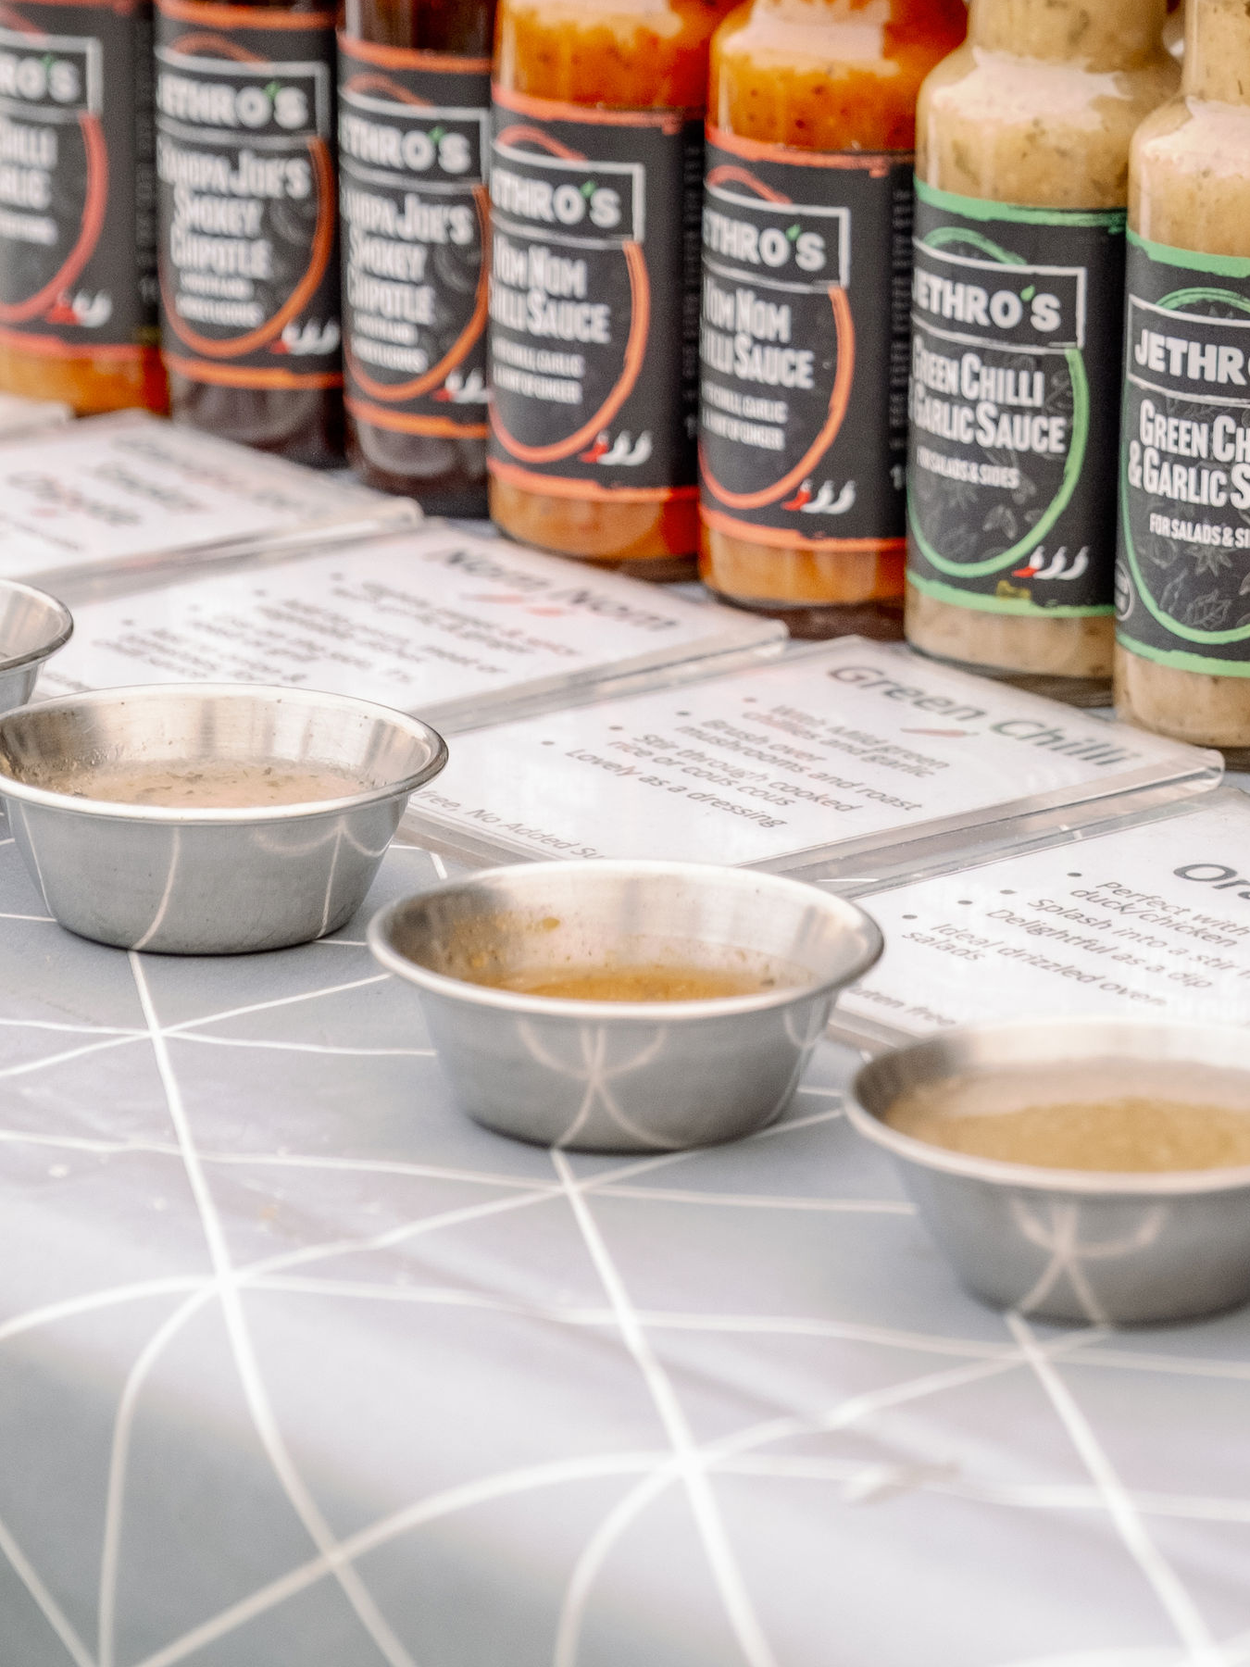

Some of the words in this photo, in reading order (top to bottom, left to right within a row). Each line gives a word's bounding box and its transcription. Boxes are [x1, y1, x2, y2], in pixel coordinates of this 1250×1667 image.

[526, 287, 611, 345] SAUCE
[735, 287, 791, 344] NOM
[733, 332, 815, 390] SAUCE
[961, 352, 1045, 408] CHILLI
[975, 400, 1067, 454] SAUCE
[1140, 399, 1209, 459] GREEN
[1143, 446, 1228, 508] GARLIC
[1149, 512, 1170, 536] FOR
[1170, 516, 1221, 547] SALADS
[1222, 526, 1234, 548] &
[828, 665, 988, 722] Green
[989, 718, 1142, 766] Chilli
[607, 739, 655, 758] rice
[652, 755, 684, 768] or
[681, 763, 740, 789] cous
[737, 783, 797, 808] cous
[632, 733, 679, 752] Stir
[676, 747, 770, 783] through
[768, 779, 864, 814] cooked
[675, 725, 810, 774] mushrooms
[808, 770, 865, 790] and
[857, 784, 922, 813] roast
[767, 742, 827, 762] over
[565, 748, 643, 778] Lovely
[638, 773, 671, 787] as
[667, 783, 688, 795] a
[686, 789, 788, 829] dressing
[465, 808, 501, 825] No
[498, 822, 580, 852] Added
[901, 930, 988, 963] salads
[1027, 898, 1115, 931] Splash
[1112, 925, 1169, 950] into
[1168, 946, 1190, 957] a
[1188, 950, 1240, 972] stir
[1070, 889, 1238, 949] duck/chicken
[931, 922, 1001, 951] Ideal
[996, 944, 1100, 986] drizzled
[1098, 980, 1167, 1008] over
[986, 908, 1118, 955] Delightful
[1110, 951, 1145, 967] as
[1144, 964, 1166, 975] a
[1168, 968, 1214, 991] dip
